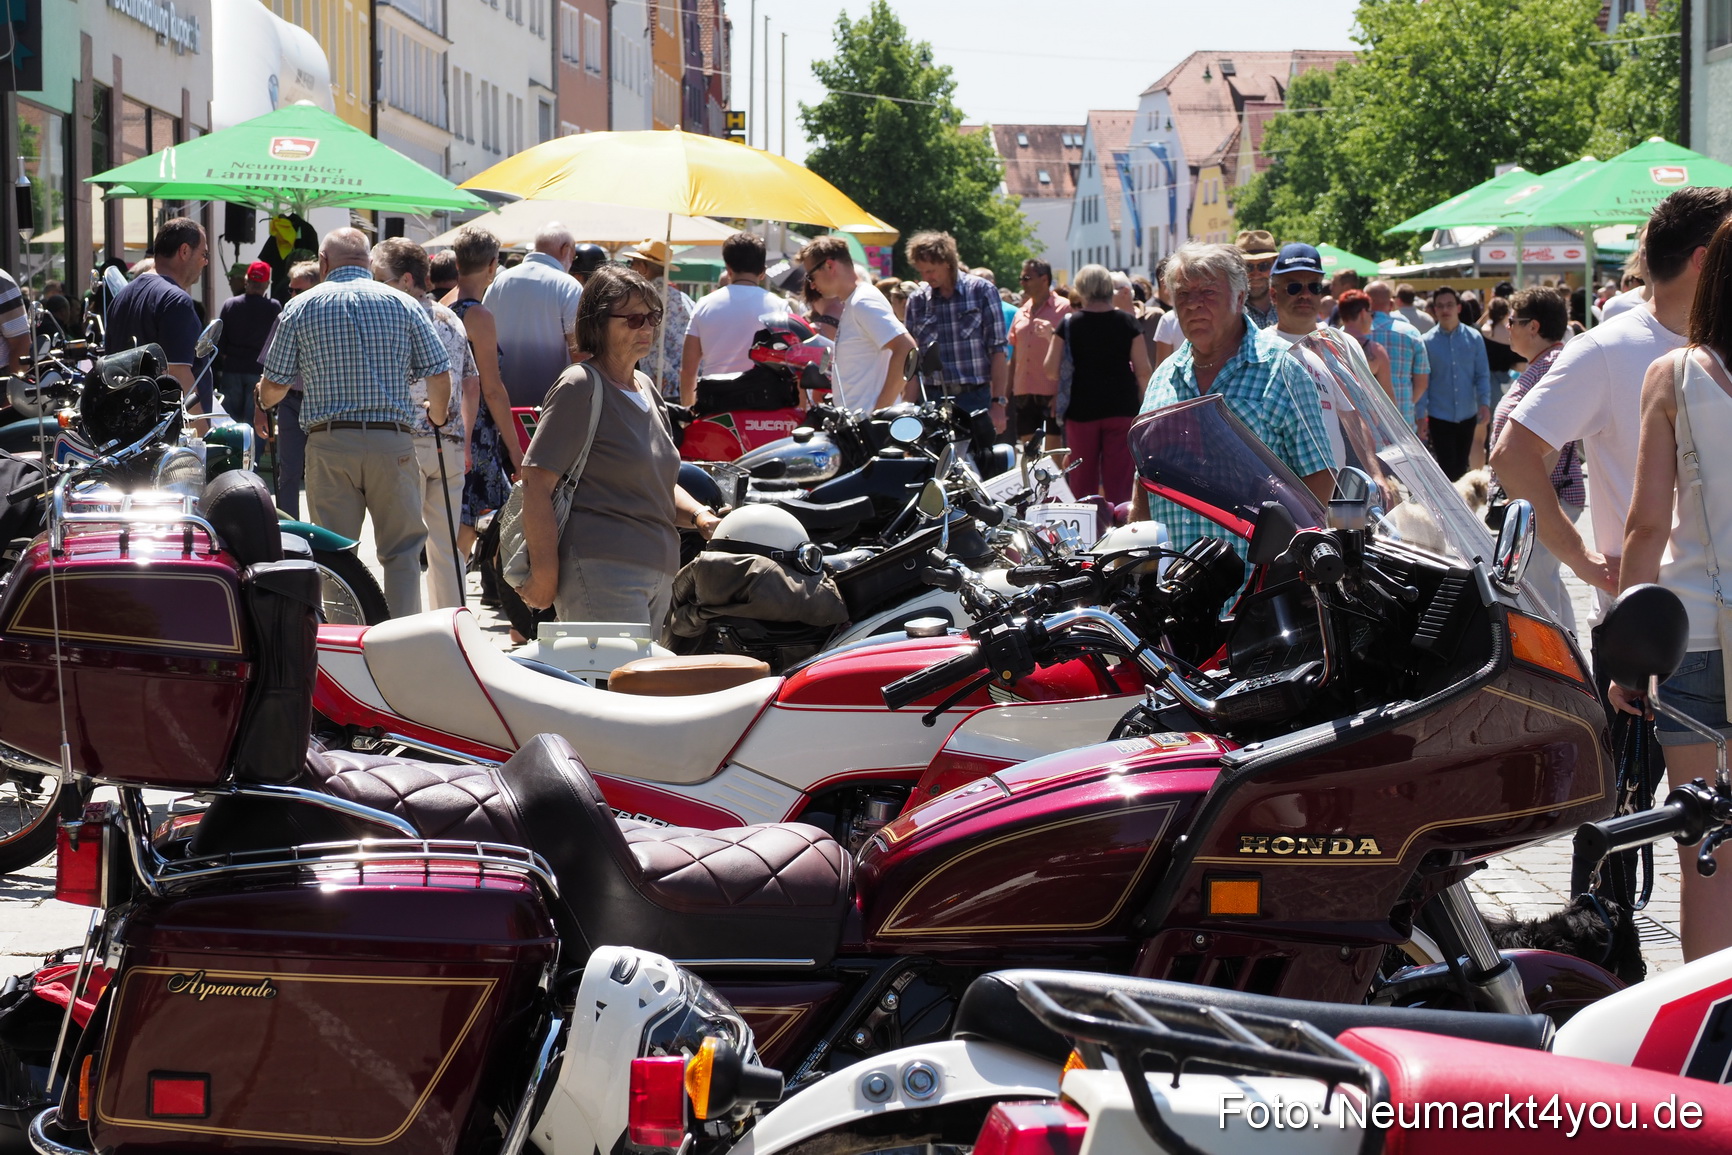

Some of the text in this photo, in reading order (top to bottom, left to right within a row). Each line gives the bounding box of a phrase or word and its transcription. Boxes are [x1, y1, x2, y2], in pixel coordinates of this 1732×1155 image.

[231, 161, 346, 174] Neumarkter
[205, 168, 363, 187] Lammsbräu
[745, 420, 798, 431] DUCATI
[1239, 836, 1382, 855] HONDA
[167, 971, 277, 1001] Aspencade
